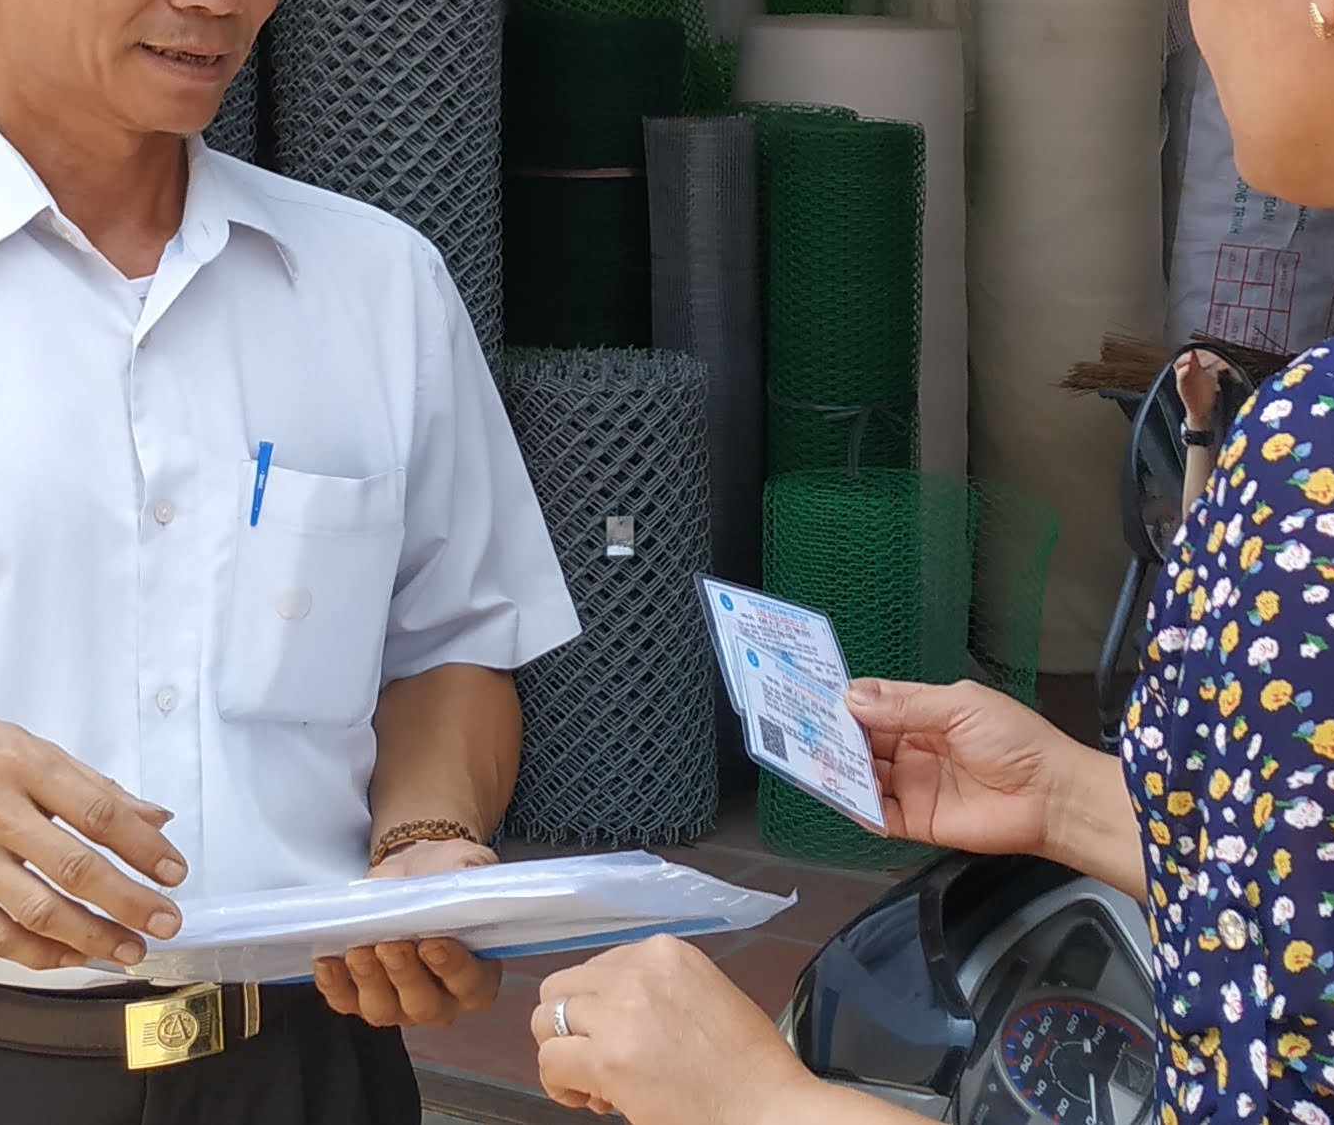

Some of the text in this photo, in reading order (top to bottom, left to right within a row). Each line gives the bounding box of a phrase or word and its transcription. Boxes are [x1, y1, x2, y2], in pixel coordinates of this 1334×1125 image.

[1039, 1015, 1052, 1036] 100
[1066, 1014, 1080, 1035] 120
[1092, 1025, 1106, 1046] 140
[1035, 1079, 1048, 1098] 40
